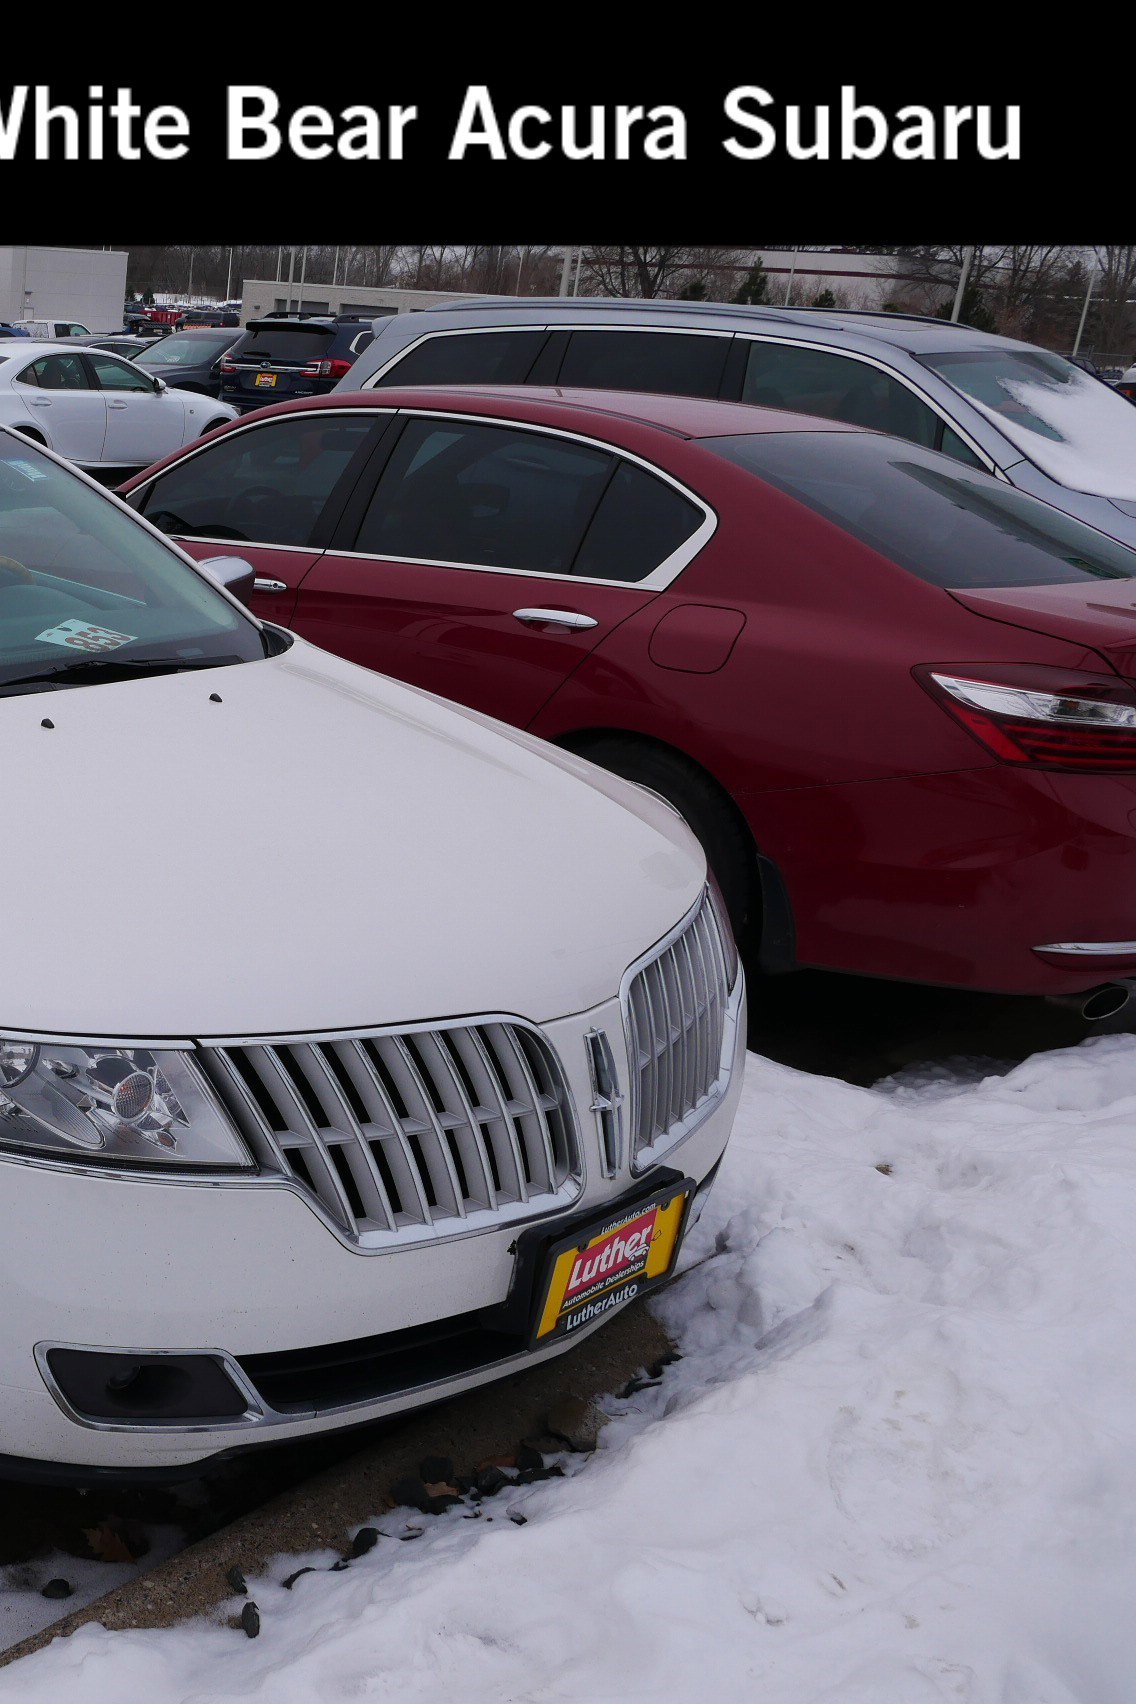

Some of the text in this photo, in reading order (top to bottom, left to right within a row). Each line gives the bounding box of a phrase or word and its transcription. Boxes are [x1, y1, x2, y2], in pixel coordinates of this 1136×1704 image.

[64, 626, 132, 653] 853
[600, 1202, 656, 1236] LutherAuto.com
[568, 1224, 653, 1291] Luther
[562, 1260, 645, 1309] Automobile Dealerships
[566, 1284, 638, 1331] LutherAuto
